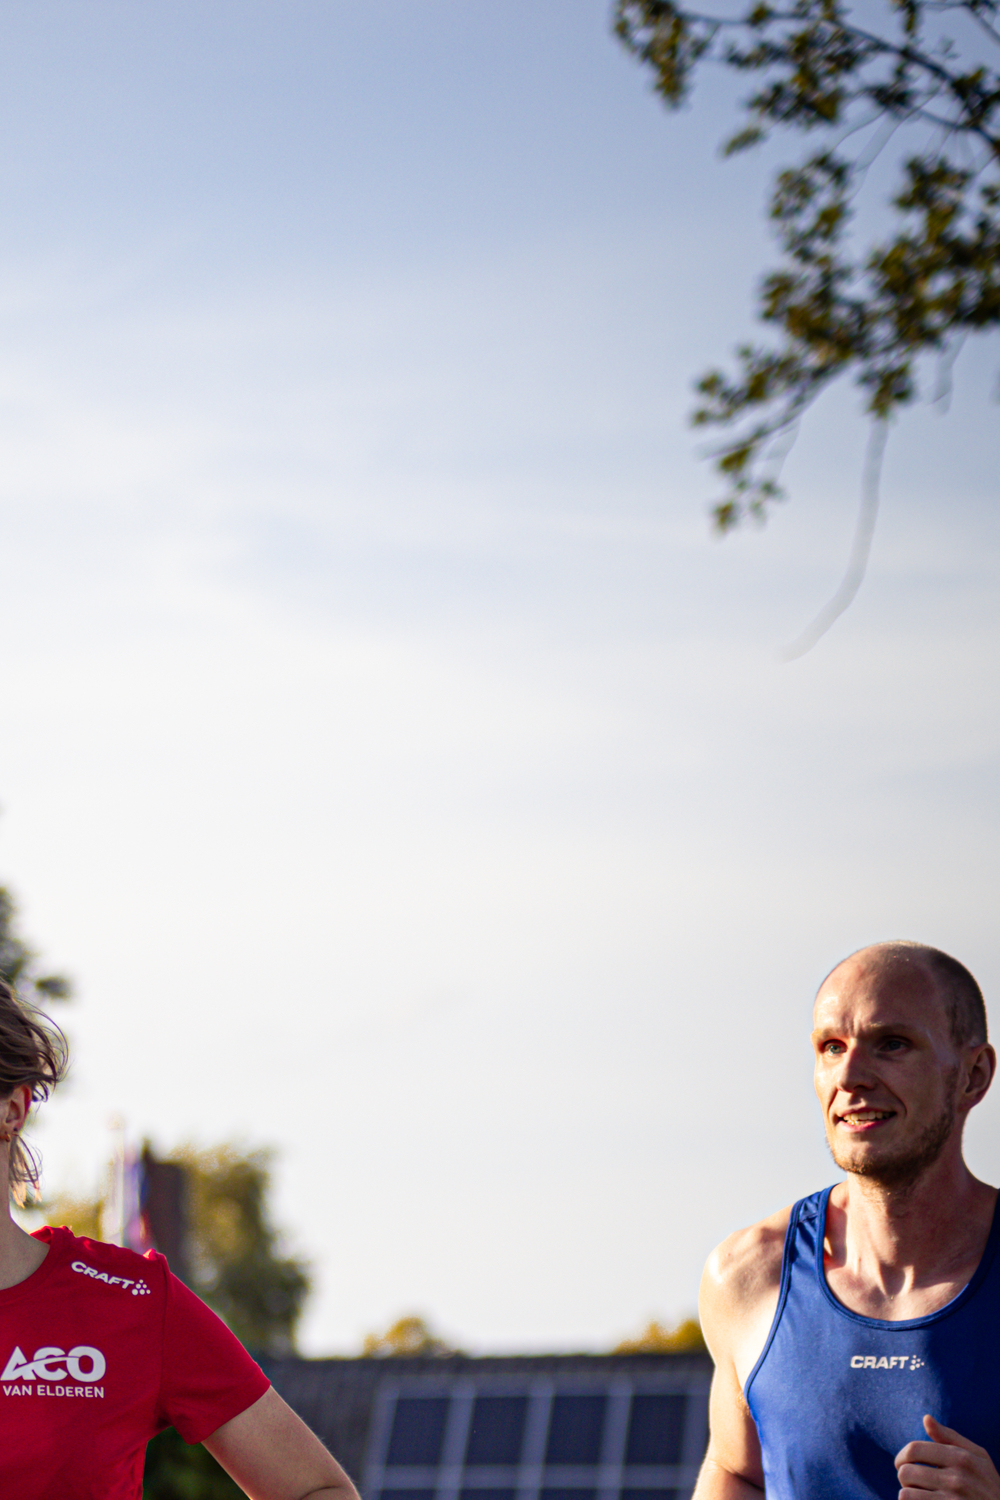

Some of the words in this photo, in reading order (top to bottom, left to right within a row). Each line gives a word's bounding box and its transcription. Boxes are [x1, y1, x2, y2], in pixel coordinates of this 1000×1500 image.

[71, 1261, 135, 1290] CRAFT
[0, 1345, 106, 1382] ACO
[850, 1355, 909, 1369] CRAFT
[3, 1385, 32, 1396] VAN
[37, 1385, 105, 1398] ELDEREN
